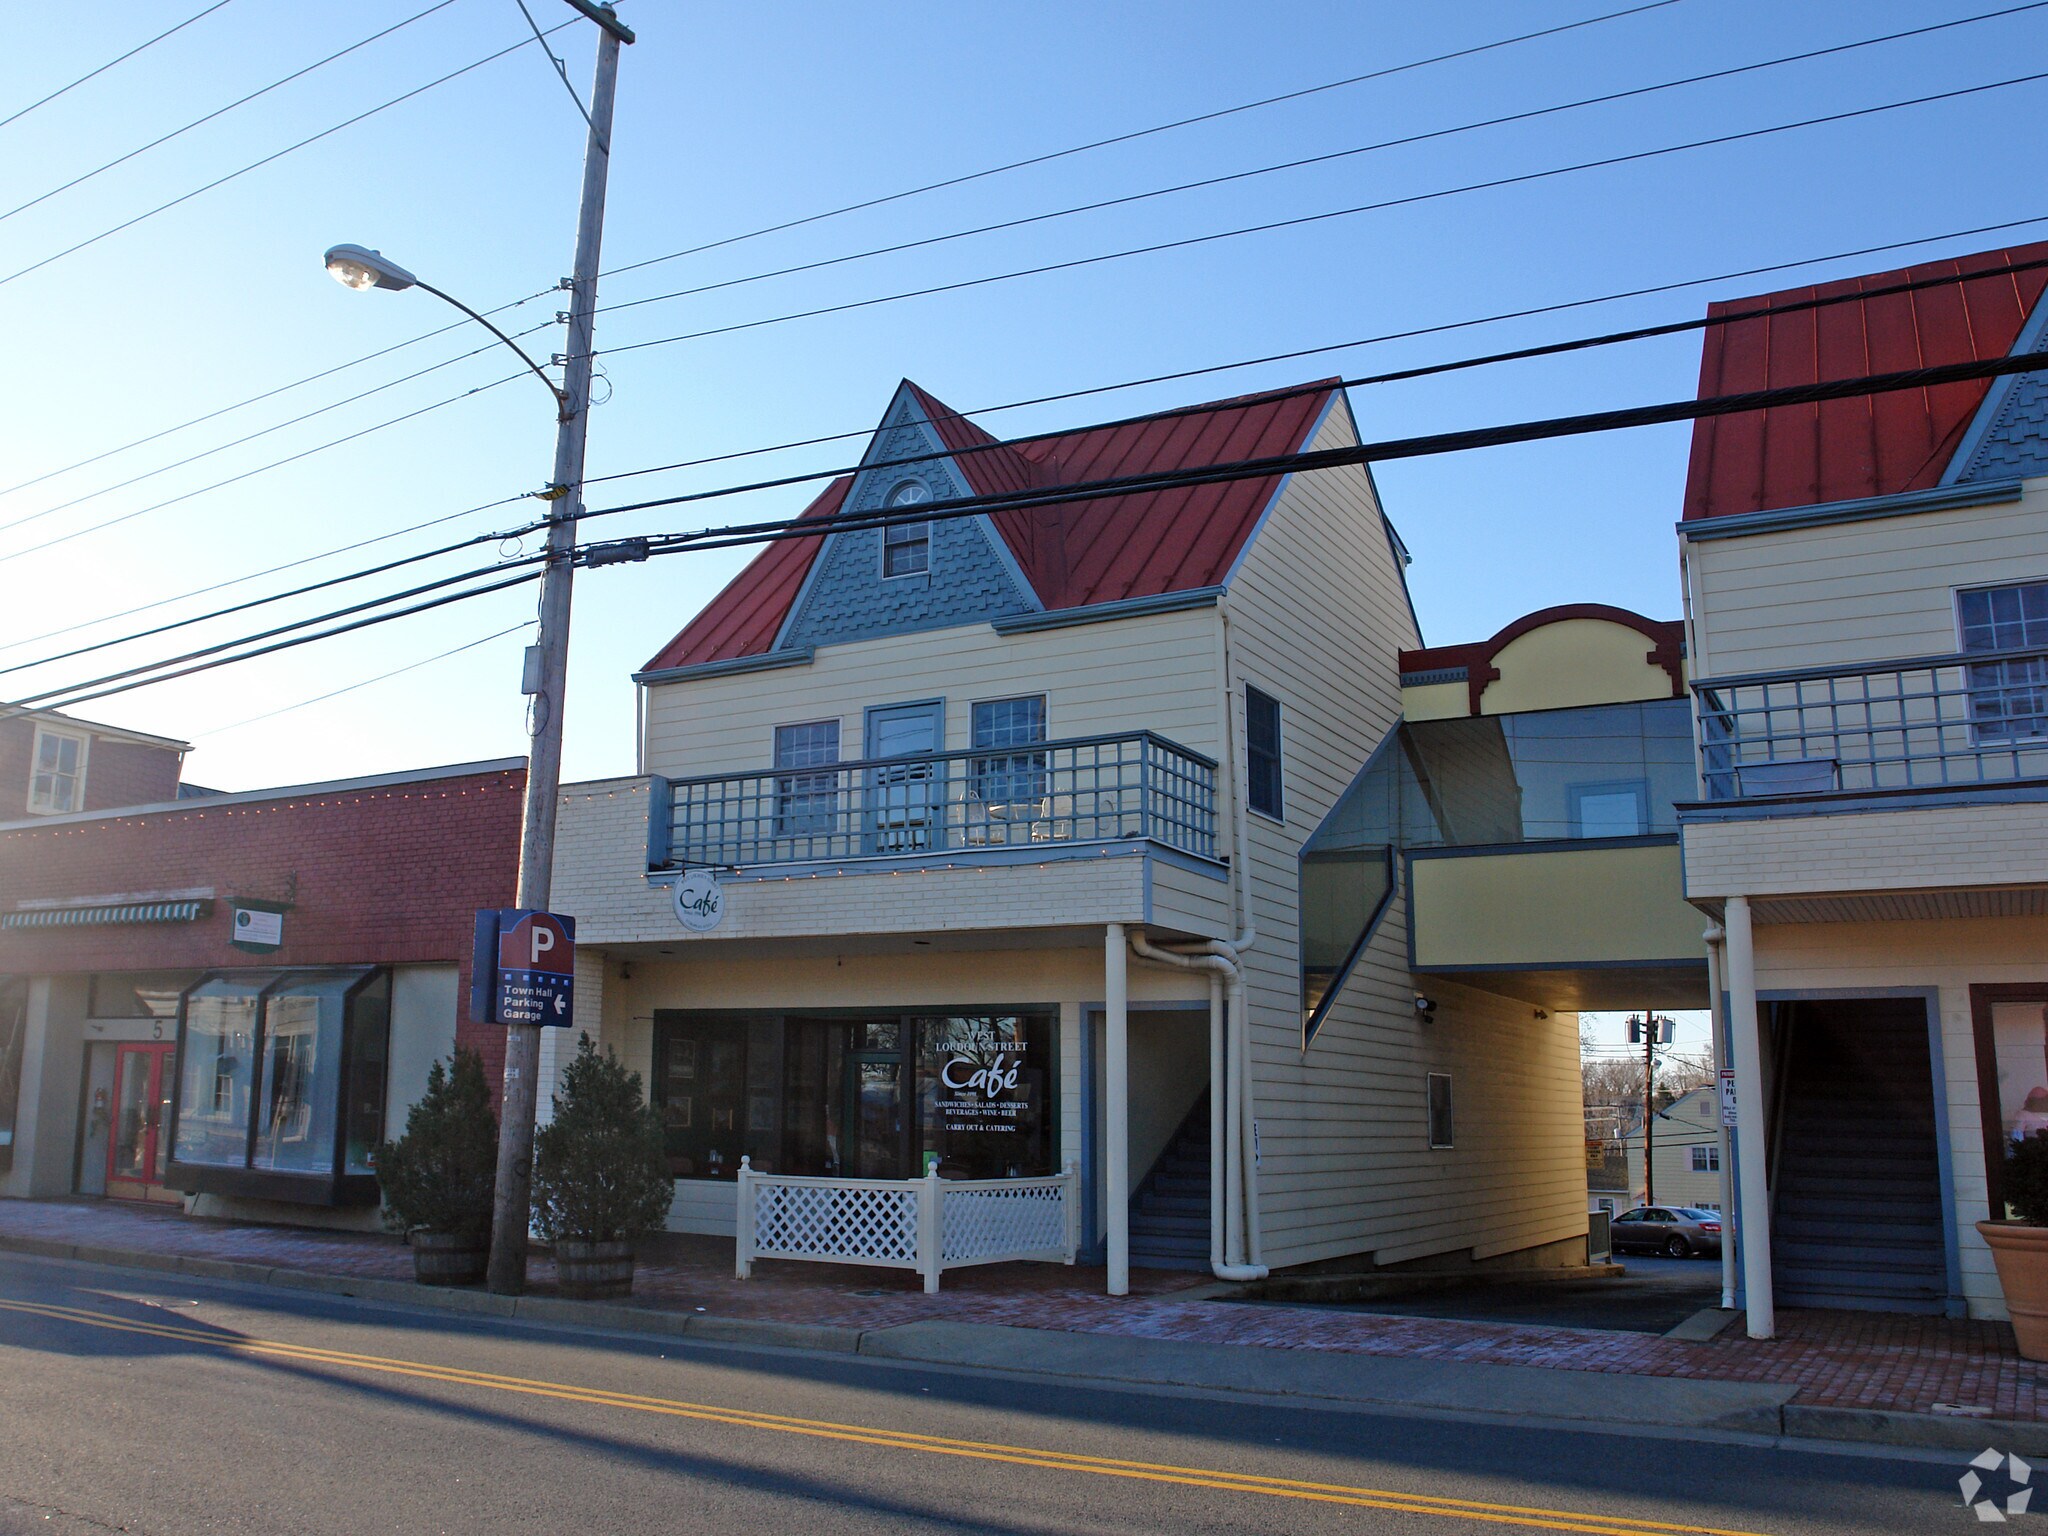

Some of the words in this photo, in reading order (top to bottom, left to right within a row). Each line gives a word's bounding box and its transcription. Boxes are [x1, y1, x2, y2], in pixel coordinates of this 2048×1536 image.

[680, 889, 719, 917] Café
[531, 925, 555, 963] P
[504, 985, 534, 995] Town
[536, 987, 552, 997] Hall
[504, 997, 543, 1010] Parking
[503, 1009, 541, 1021] Garage
[153, 1020, 163, 1039] 5
[967, 1031, 996, 1041] WEST
[936, 1042, 986, 1052] LOUDOUN
[987, 1041, 1028, 1052] STREET
[942, 1053, 1021, 1098] Café
[974, 1101, 996, 1109] SALADS
[1000, 1101, 1029, 1109] DESSERTS
[945, 1108, 979, 1116] BEVERAGES
[1001, 1109, 1017, 1117] BEER
[985, 1124, 1016, 1132] CATERING
